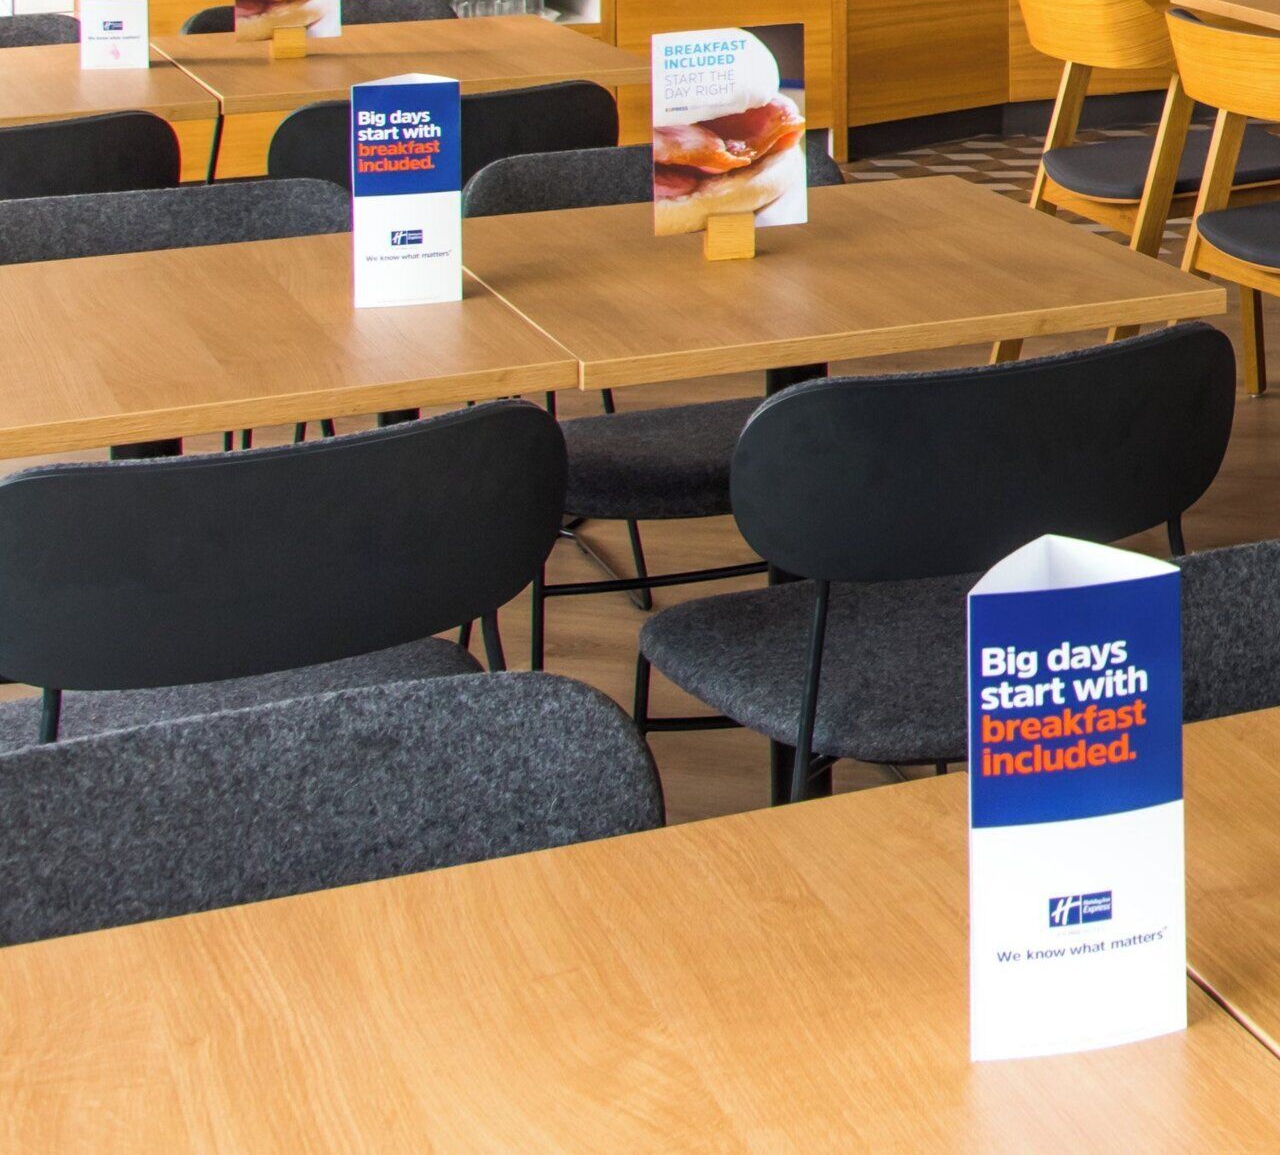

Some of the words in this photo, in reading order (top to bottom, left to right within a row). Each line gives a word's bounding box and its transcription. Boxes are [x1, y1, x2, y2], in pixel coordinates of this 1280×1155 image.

[664, 39, 747, 57] BREAKFAST
[664, 53, 735, 70] INCLUDED
[664, 71, 706, 86] START
[710, 68, 736, 83] THE
[664, 85, 690, 100] DAY
[695, 81, 736, 98] RIGHT
[358, 110, 386, 128] Big
[390, 108, 431, 126] days
[358, 126, 400, 141] start
[402, 123, 442, 139] with
[358, 139, 440, 157] breakfast
[358, 155, 435, 173] included.
[981, 646, 1038, 678] Big
[1046, 640, 1128, 672] days
[981, 679, 1066, 711] start
[1073, 665, 1149, 701] with
[981, 697, 1147, 744] breakfast
[981, 733, 1137, 778] included.
[997, 950, 1021, 963] We
[1026, 948, 1066, 960] know
[1070, 941, 1105, 956] what
[1110, 929, 1164, 950] matters
